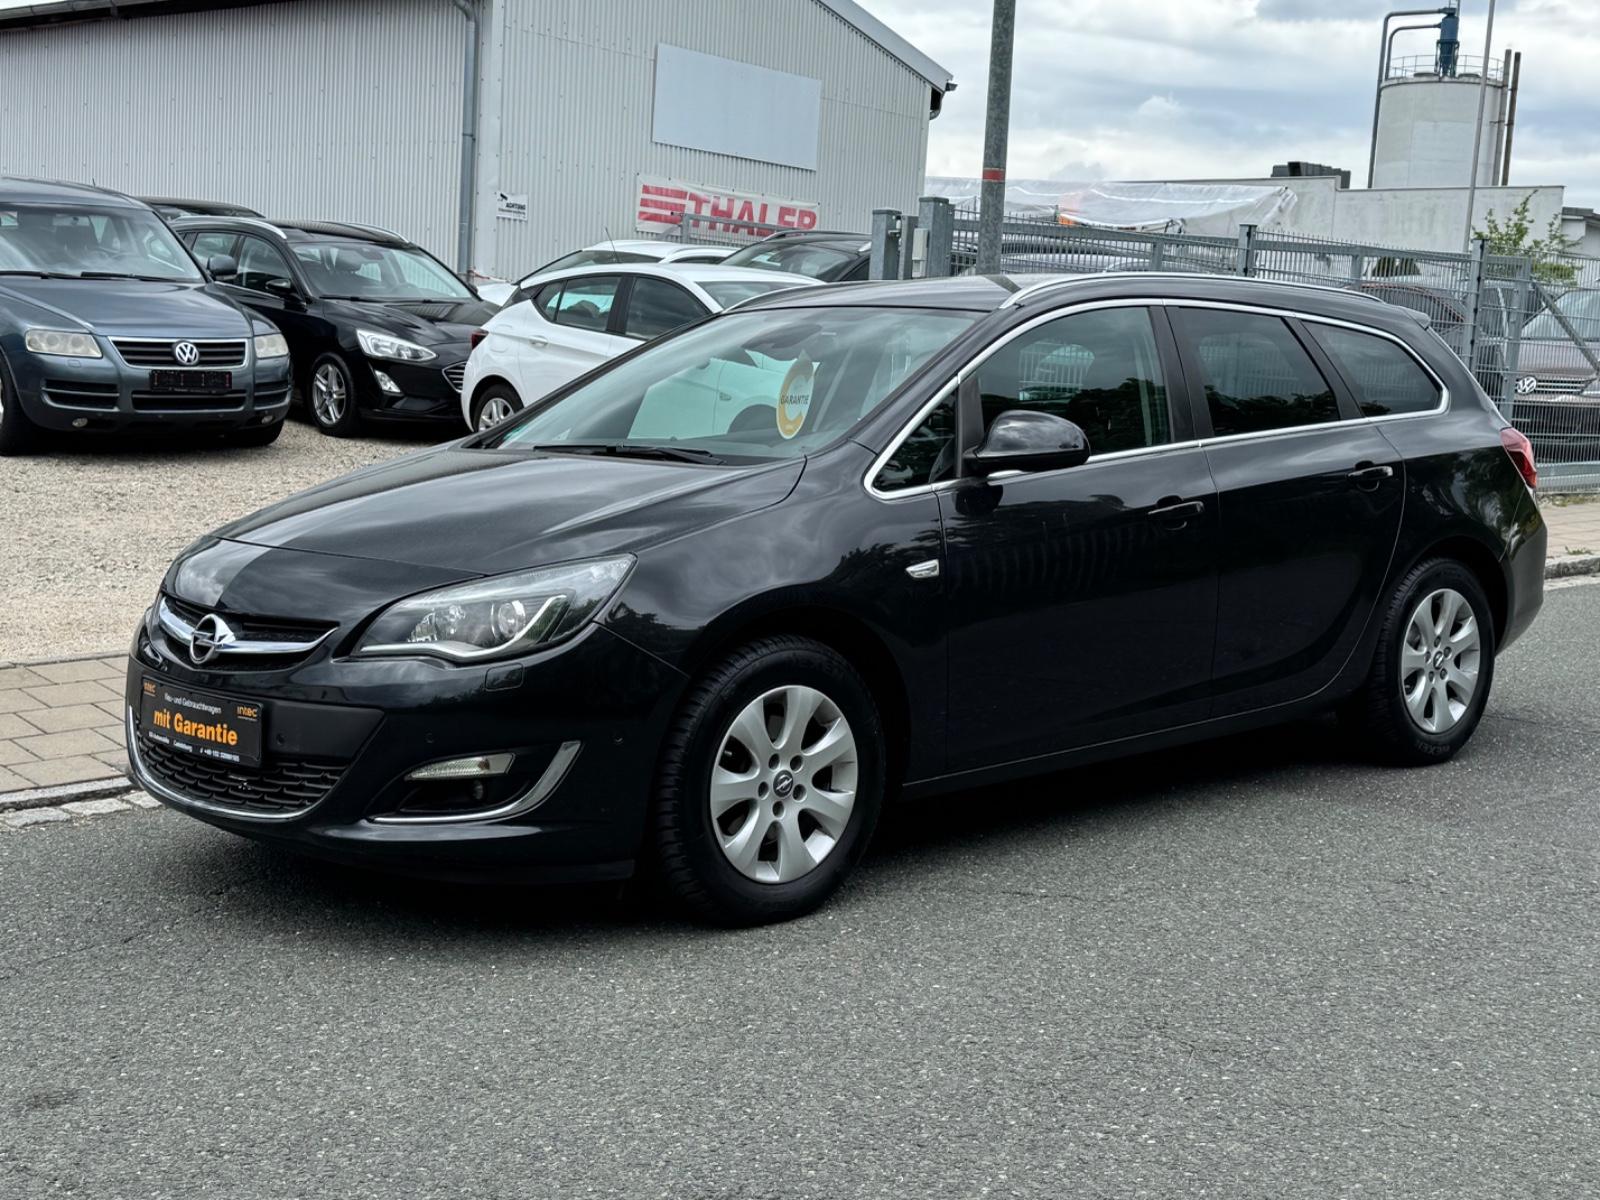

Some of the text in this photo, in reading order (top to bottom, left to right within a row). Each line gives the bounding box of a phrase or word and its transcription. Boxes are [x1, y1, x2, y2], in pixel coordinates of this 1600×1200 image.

[781, 394, 810, 405] GARANTIE
[153, 709, 171, 729] mit
[174, 712, 238, 746] Garantie
